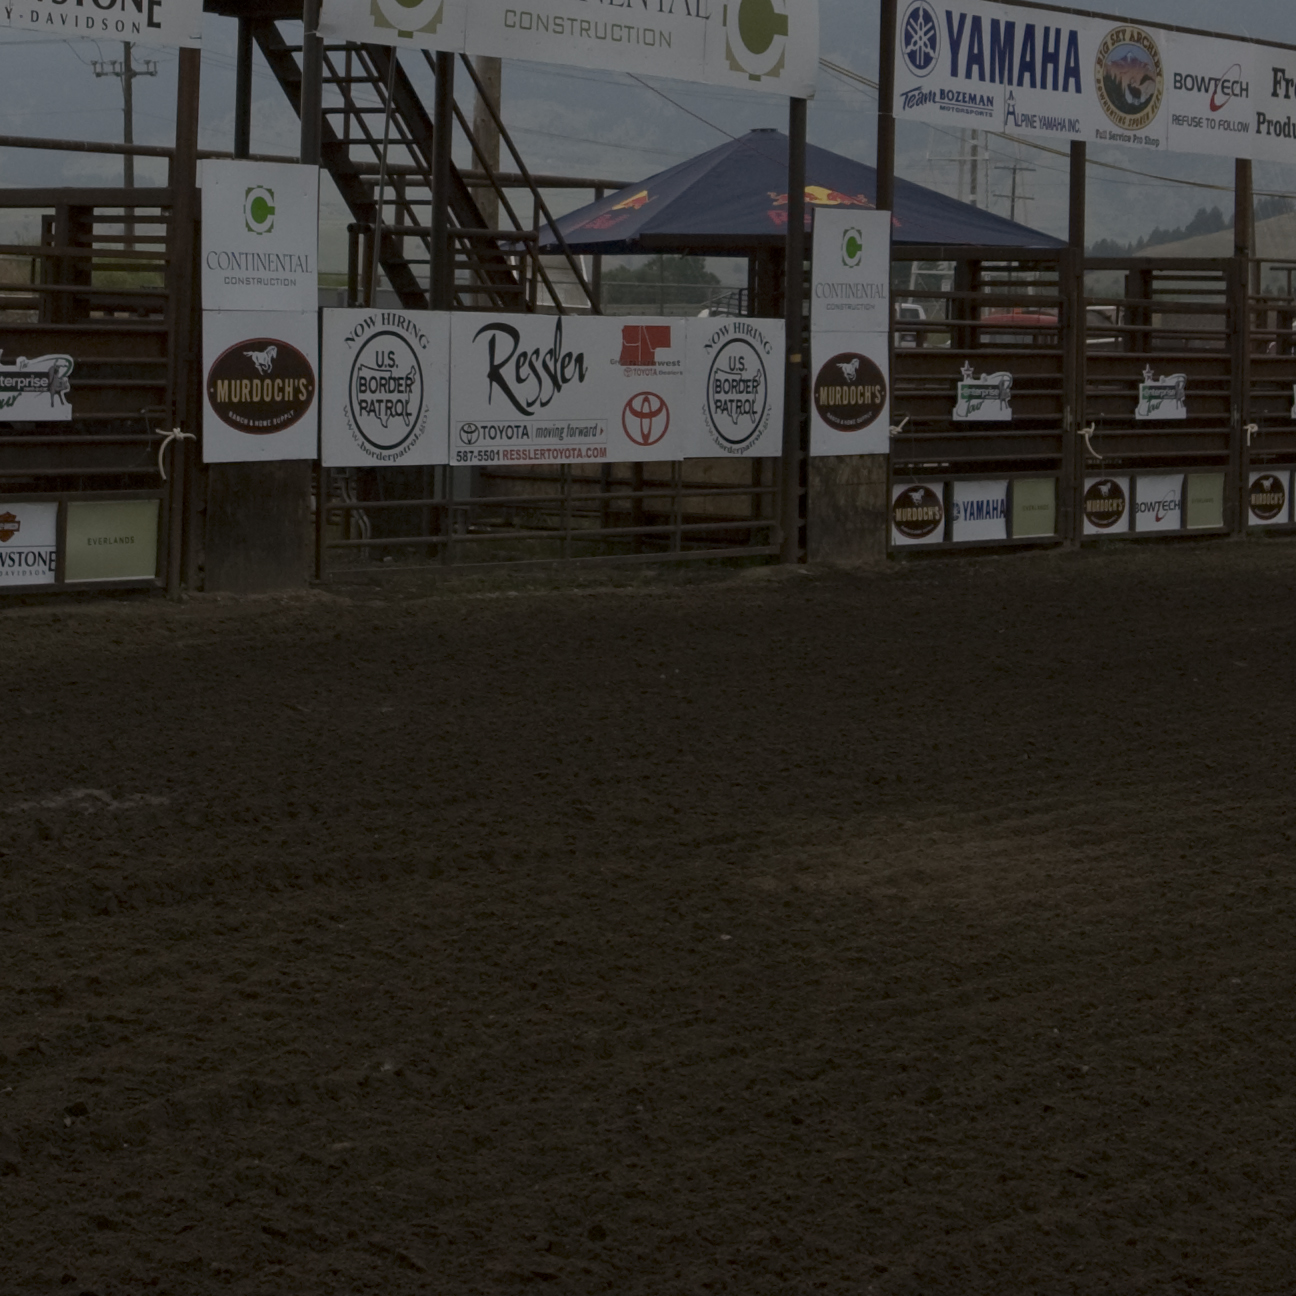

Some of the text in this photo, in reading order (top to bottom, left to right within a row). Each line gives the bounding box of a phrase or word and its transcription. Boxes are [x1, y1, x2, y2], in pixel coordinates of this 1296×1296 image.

[503, 9, 673, 48] CONSTRUCTION
[1110, 29, 1127, 46] SKY
[945, 9, 1082, 94] YAMAHA
[1173, 72, 1249, 99] BOWTECH
[900, 86, 994, 111] Team BOZEMAN
[939, 105, 994, 118] MOTORSPORTS
[1038, 114, 1066, 131] YAMAHA
[1067, 118, 1081, 134] INC.
[1172, 114, 1250, 134] REFUSE TO FOLLOW
[206, 250, 312, 274] CONTINENTAL
[224, 276, 297, 287] CONSTRUCTION
[815, 282, 886, 299] CONTINENTAL
[344, 312, 430, 350] NOW HIRING
[703, 322, 772, 355] NOW HIRING
[375, 350, 399, 368] U.S.
[471, 315, 589, 416] Ressler
[728, 356, 747, 372] U.S.
[216, 378, 308, 403] MURDOCH'S
[359, 376, 413, 394] BORDER
[714, 379, 759, 395] BORDER
[819, 385, 882, 406] MURDOCH'S
[359, 399, 413, 417] PATROL
[714, 399, 758, 415] PATROL
[254, 419, 272, 427] HOME
[272, 410, 295, 426] SUPPLY
[481, 423, 598, 442] TOYOTA moving forward
[456, 447, 607, 463] 587-5501 RESSLERTOYOTA.COM
[894, 506, 941, 522] MURDOCH'S
[962, 499, 1006, 521] YAMAHA
[87, 536, 135, 546] EVERLANDS
